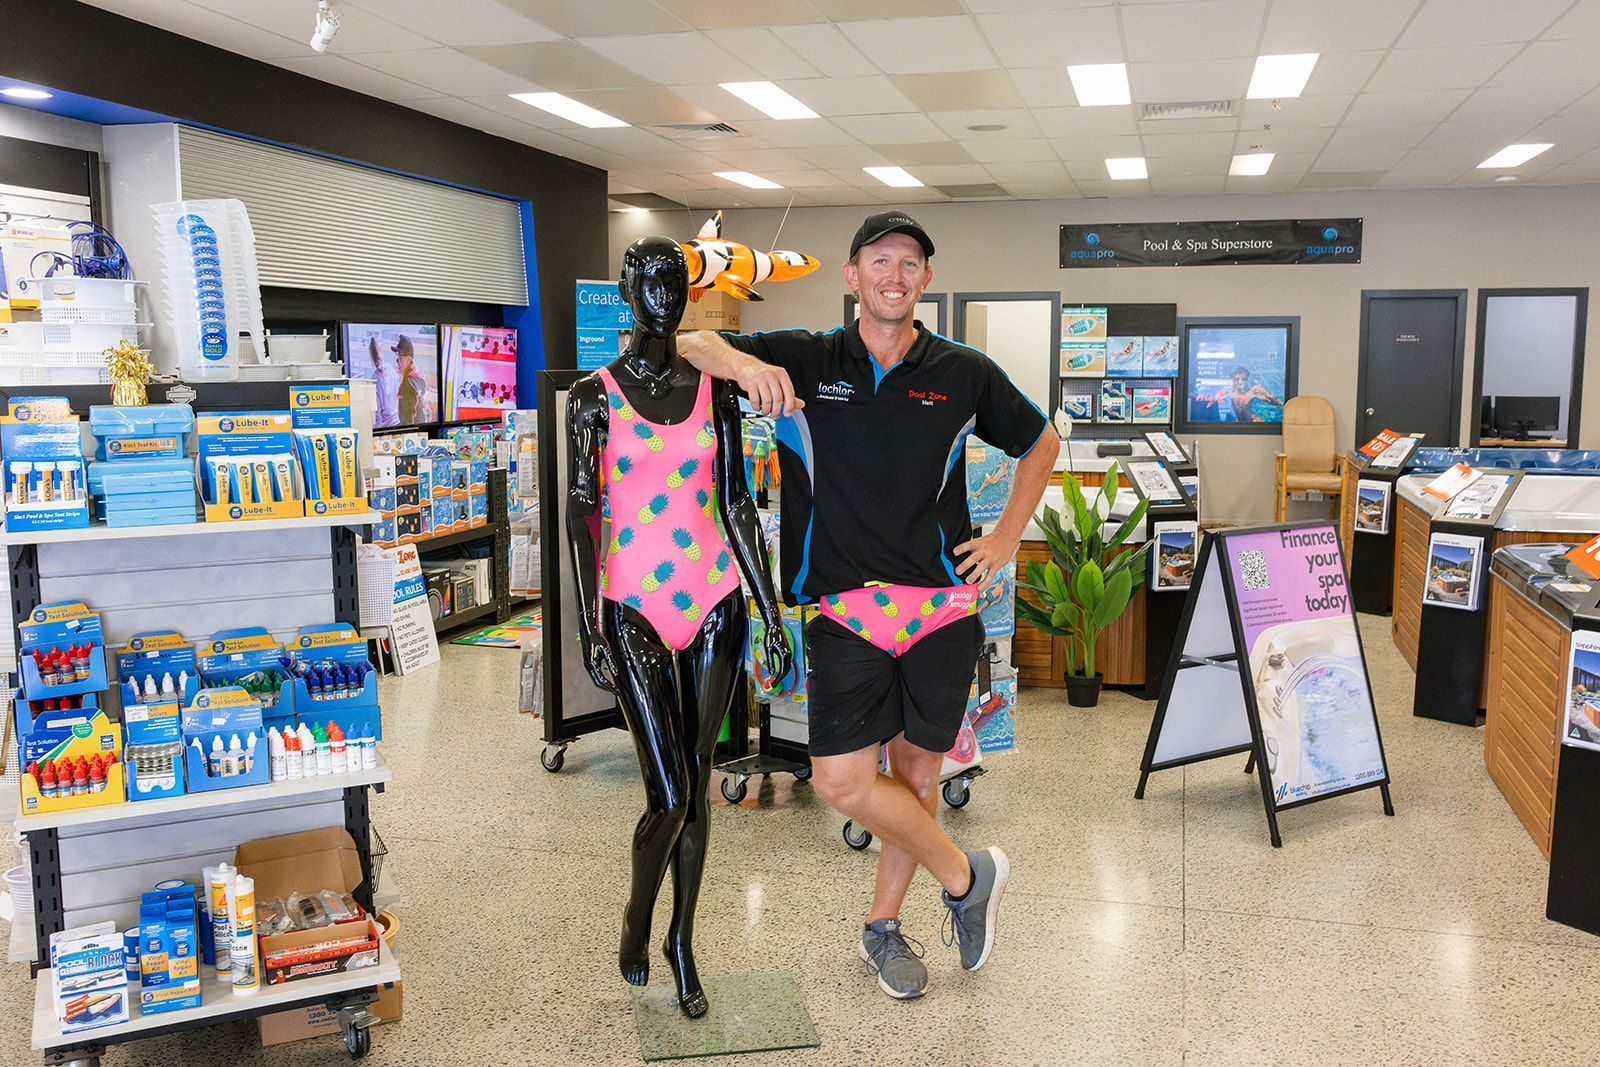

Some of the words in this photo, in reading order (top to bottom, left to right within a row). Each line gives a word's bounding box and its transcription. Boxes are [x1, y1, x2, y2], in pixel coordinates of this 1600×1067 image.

[888, 217, 914, 225] OAKLEY
[1143, 239, 1169, 251] Pool
[1172, 240, 1182, 250] &
[1186, 239, 1208, 253] Spa
[1210, 237, 1273, 254] Superstore
[1306, 244, 1355, 257] aquapro
[1070, 249, 1115, 261] aquapro
[579, 290, 620, 306] Create
[618, 311, 631, 323] at
[579, 335, 605, 344] Inground
[818, 382, 851, 398] lochlor
[908, 389, 926, 398] Pool
[928, 391, 947, 401] Zone
[1377, 432, 1397, 444] SALE
[1278, 529, 1336, 552] Finance
[1305, 550, 1340, 575] your
[406, 582, 424, 596] RULES
[1318, 573, 1344, 594] spa
[954, 592, 973, 600] budgy
[1305, 588, 1348, 614] today
[62, 611, 86, 619] Solution
[158, 640, 182, 648] Solution
[37, 738, 59, 746] Solution
[87, 952, 124, 970] BLOCK
[171, 989, 187, 997] Repair
